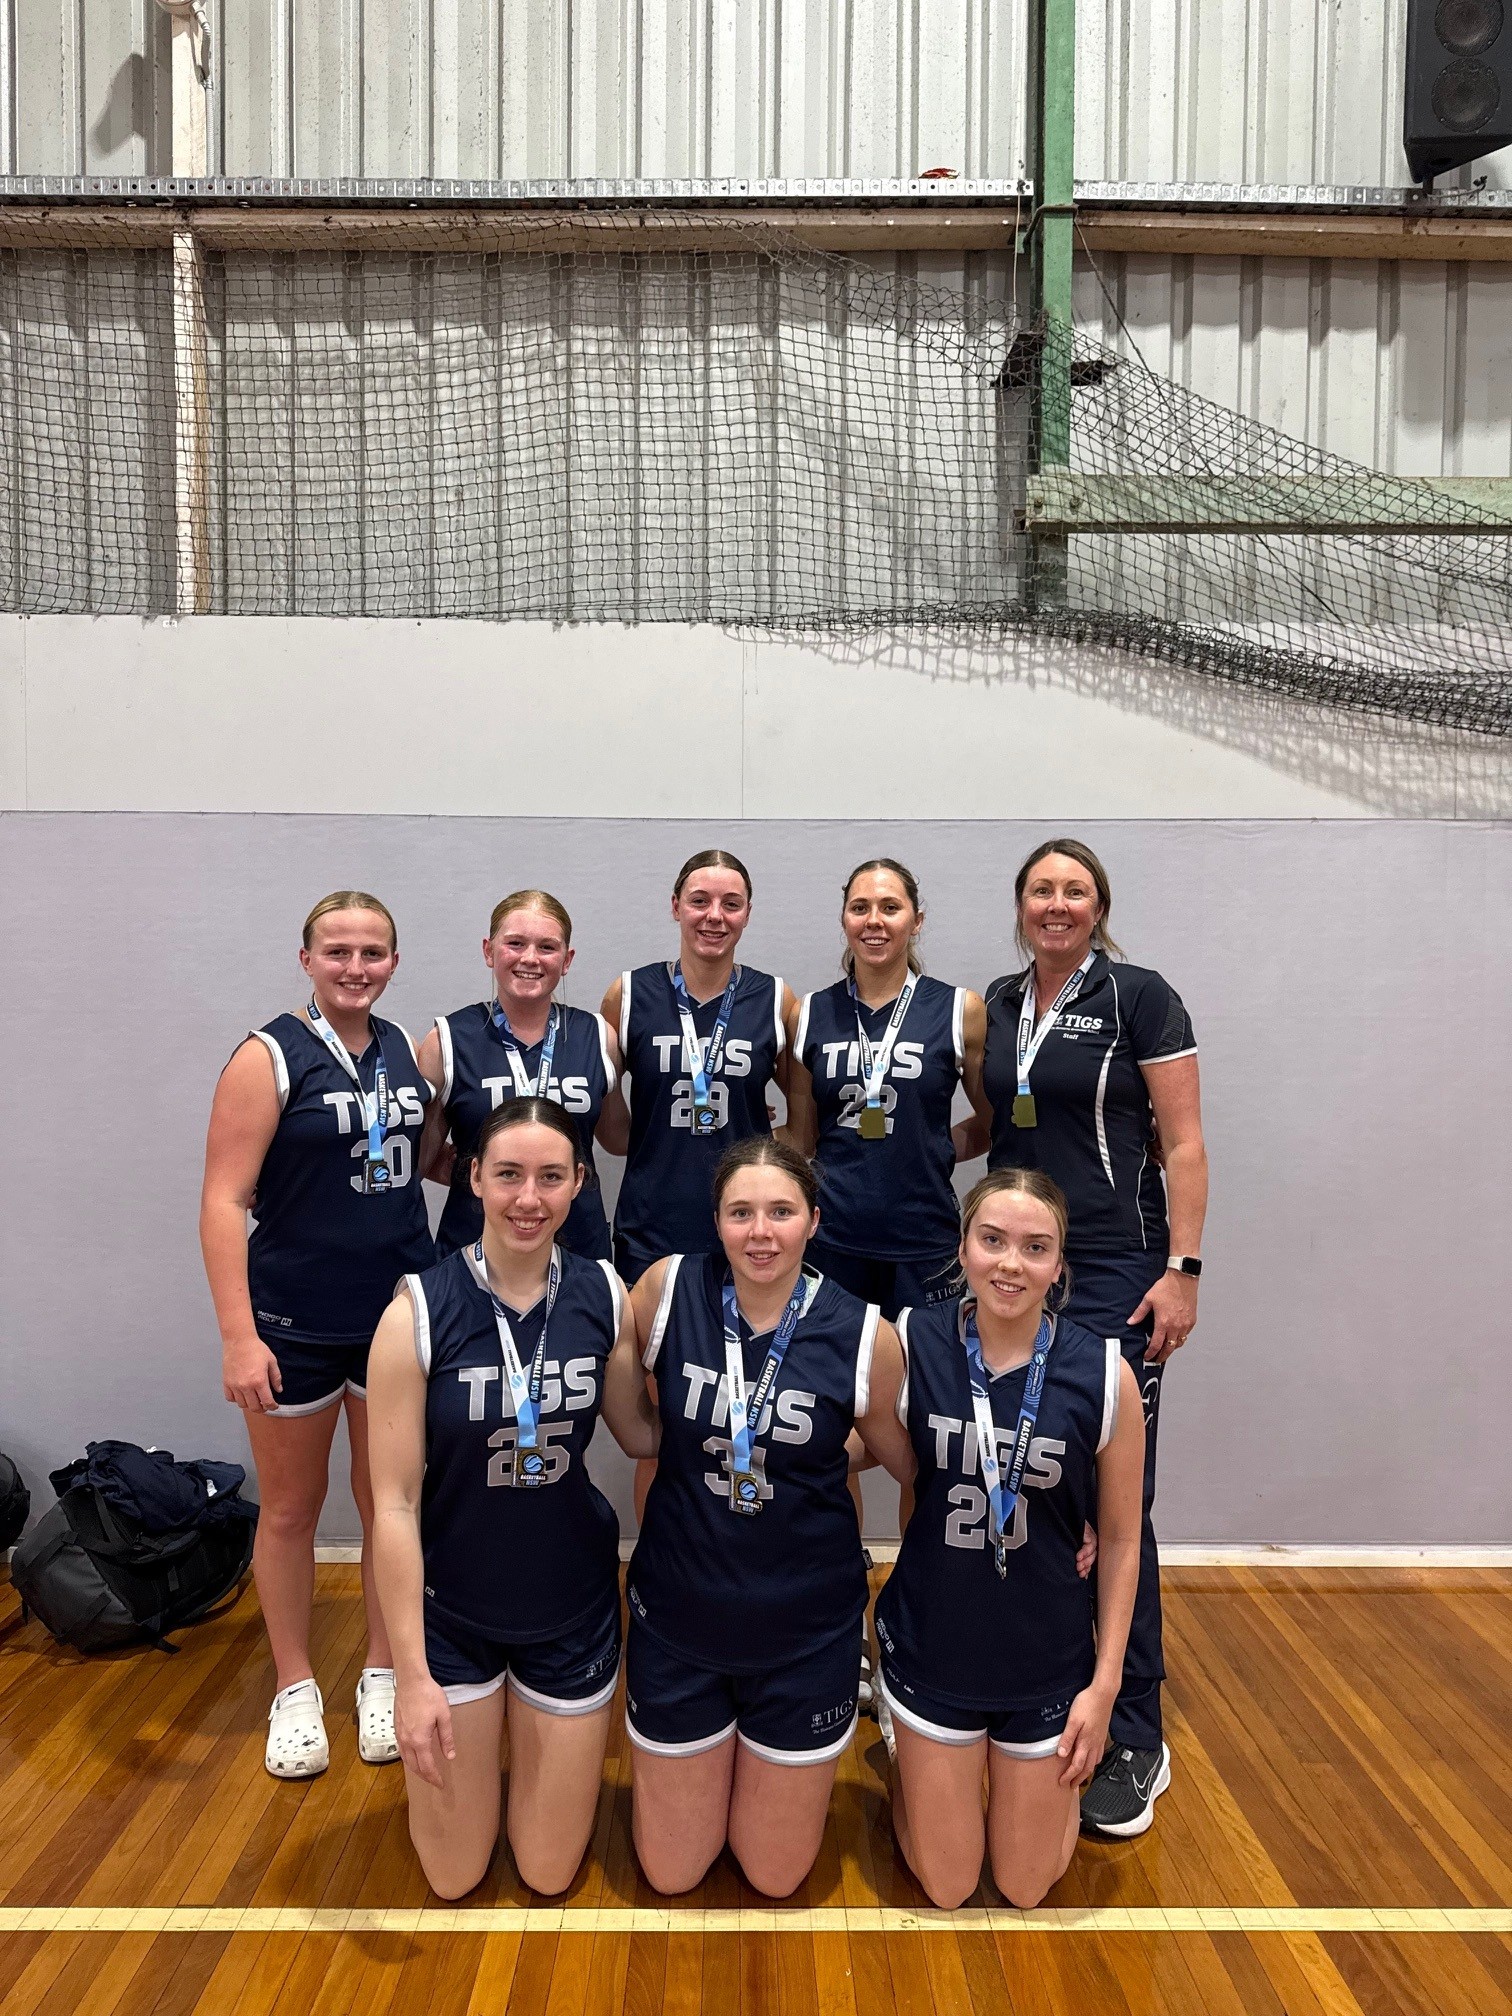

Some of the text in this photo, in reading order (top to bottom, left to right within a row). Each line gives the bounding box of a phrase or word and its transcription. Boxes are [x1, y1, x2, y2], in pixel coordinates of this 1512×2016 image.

[891, 998, 907, 1026] BASKETBALL
[1053, 981, 1076, 1010] BASKETBALL
[1071, 970, 1084, 983] NSW
[1020, 1020, 1029, 1050] BASKETBALL
[1065, 1014, 1103, 1030] TIGS
[705, 1025, 724, 1073] BASKETBALL NSW
[823, 1041, 924, 1079] TIS
[323, 1086, 424, 1134] TIGS
[378, 1073, 387, 1124] BASKETBALL NSW
[482, 1076, 591, 1113] TGS
[837, 1084, 898, 1134] 22
[458, 1356, 597, 1421] TIGS
[530, 1330, 546, 1400] BASKETBALL NSW
[747, 1358, 777, 1427] BASKETBALL NSW
[487, 1420, 574, 1487] 25
[703, 1436, 774, 1499] 31
[1008, 1419, 1032, 1491] BASKETBALL NSW
[945, 1484, 1028, 1550] 20
[824, 1695, 853, 1723] TIGS
